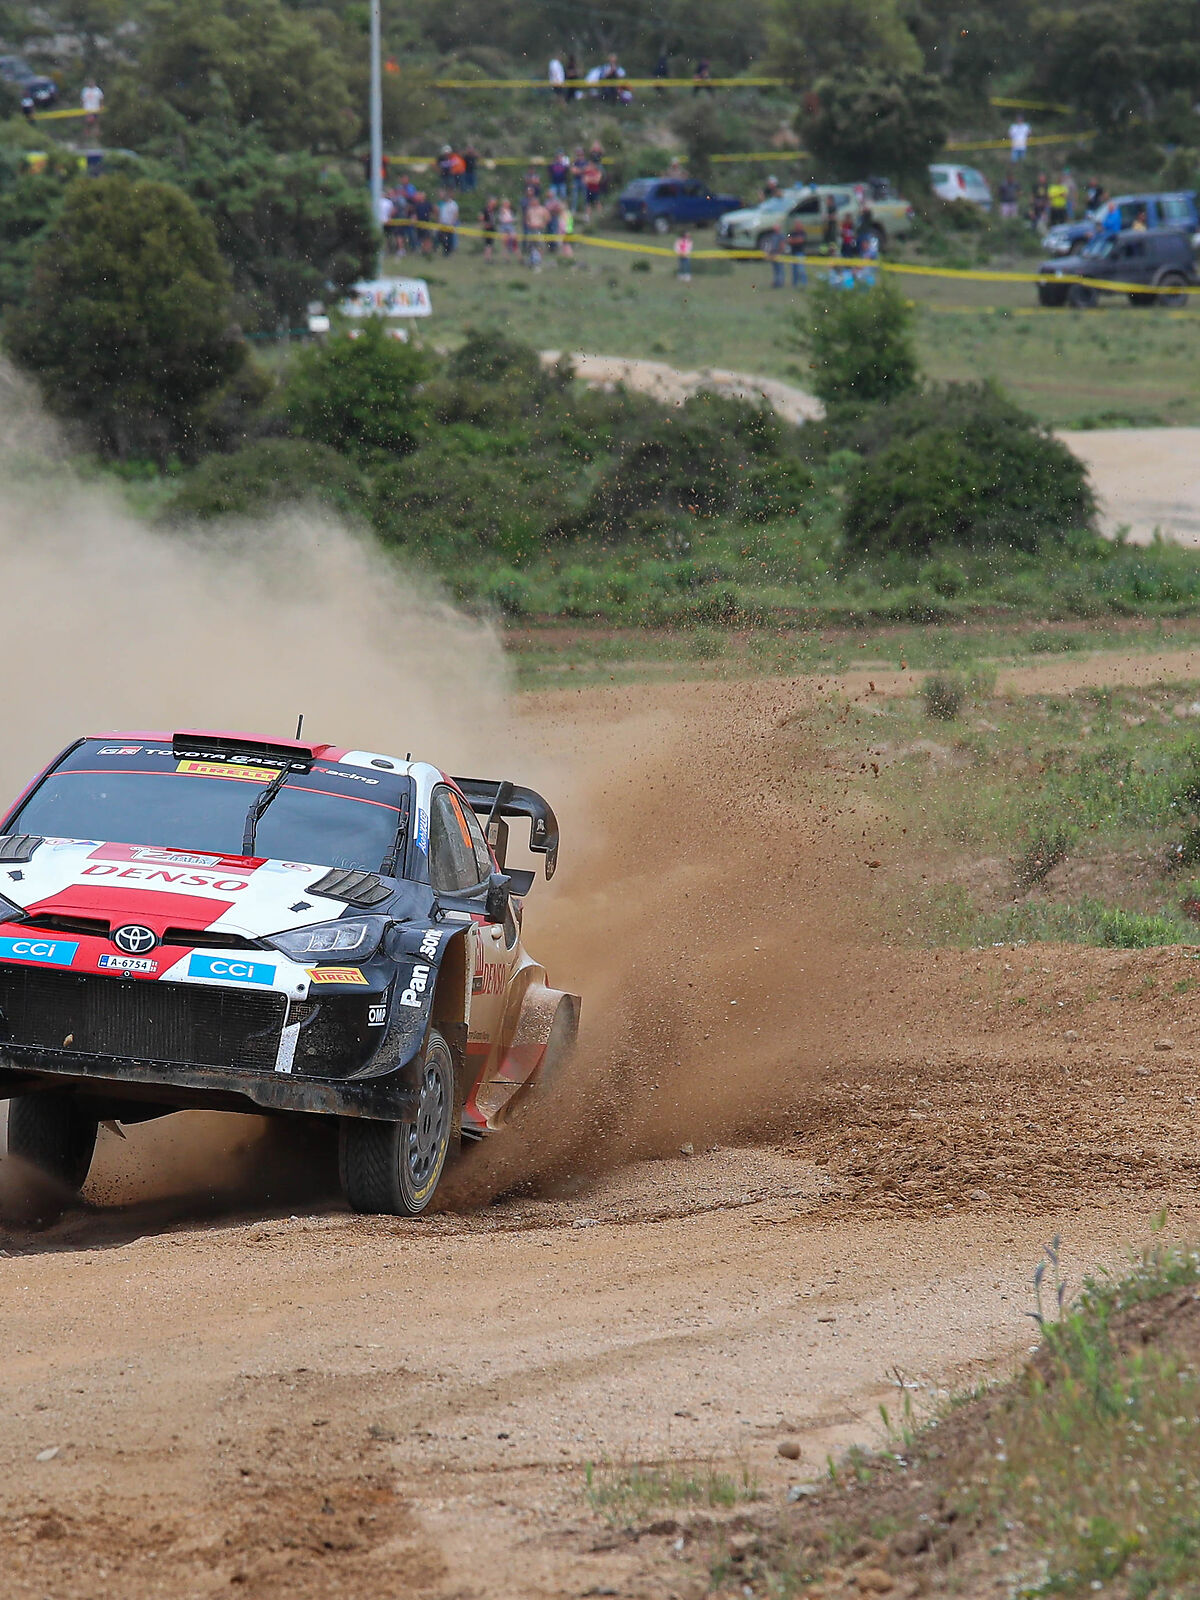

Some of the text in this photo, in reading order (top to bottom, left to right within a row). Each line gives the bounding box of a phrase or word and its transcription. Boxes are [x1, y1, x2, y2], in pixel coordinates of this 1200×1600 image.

[145, 749, 225, 760] TOYOTA
[310, 766, 380, 786] Racing
[187, 762, 279, 780] PIRELLI
[81, 864, 249, 891] DENSO
[110, 958, 148, 970] A-6754
[310, 969, 362, 983] PIRELLI
